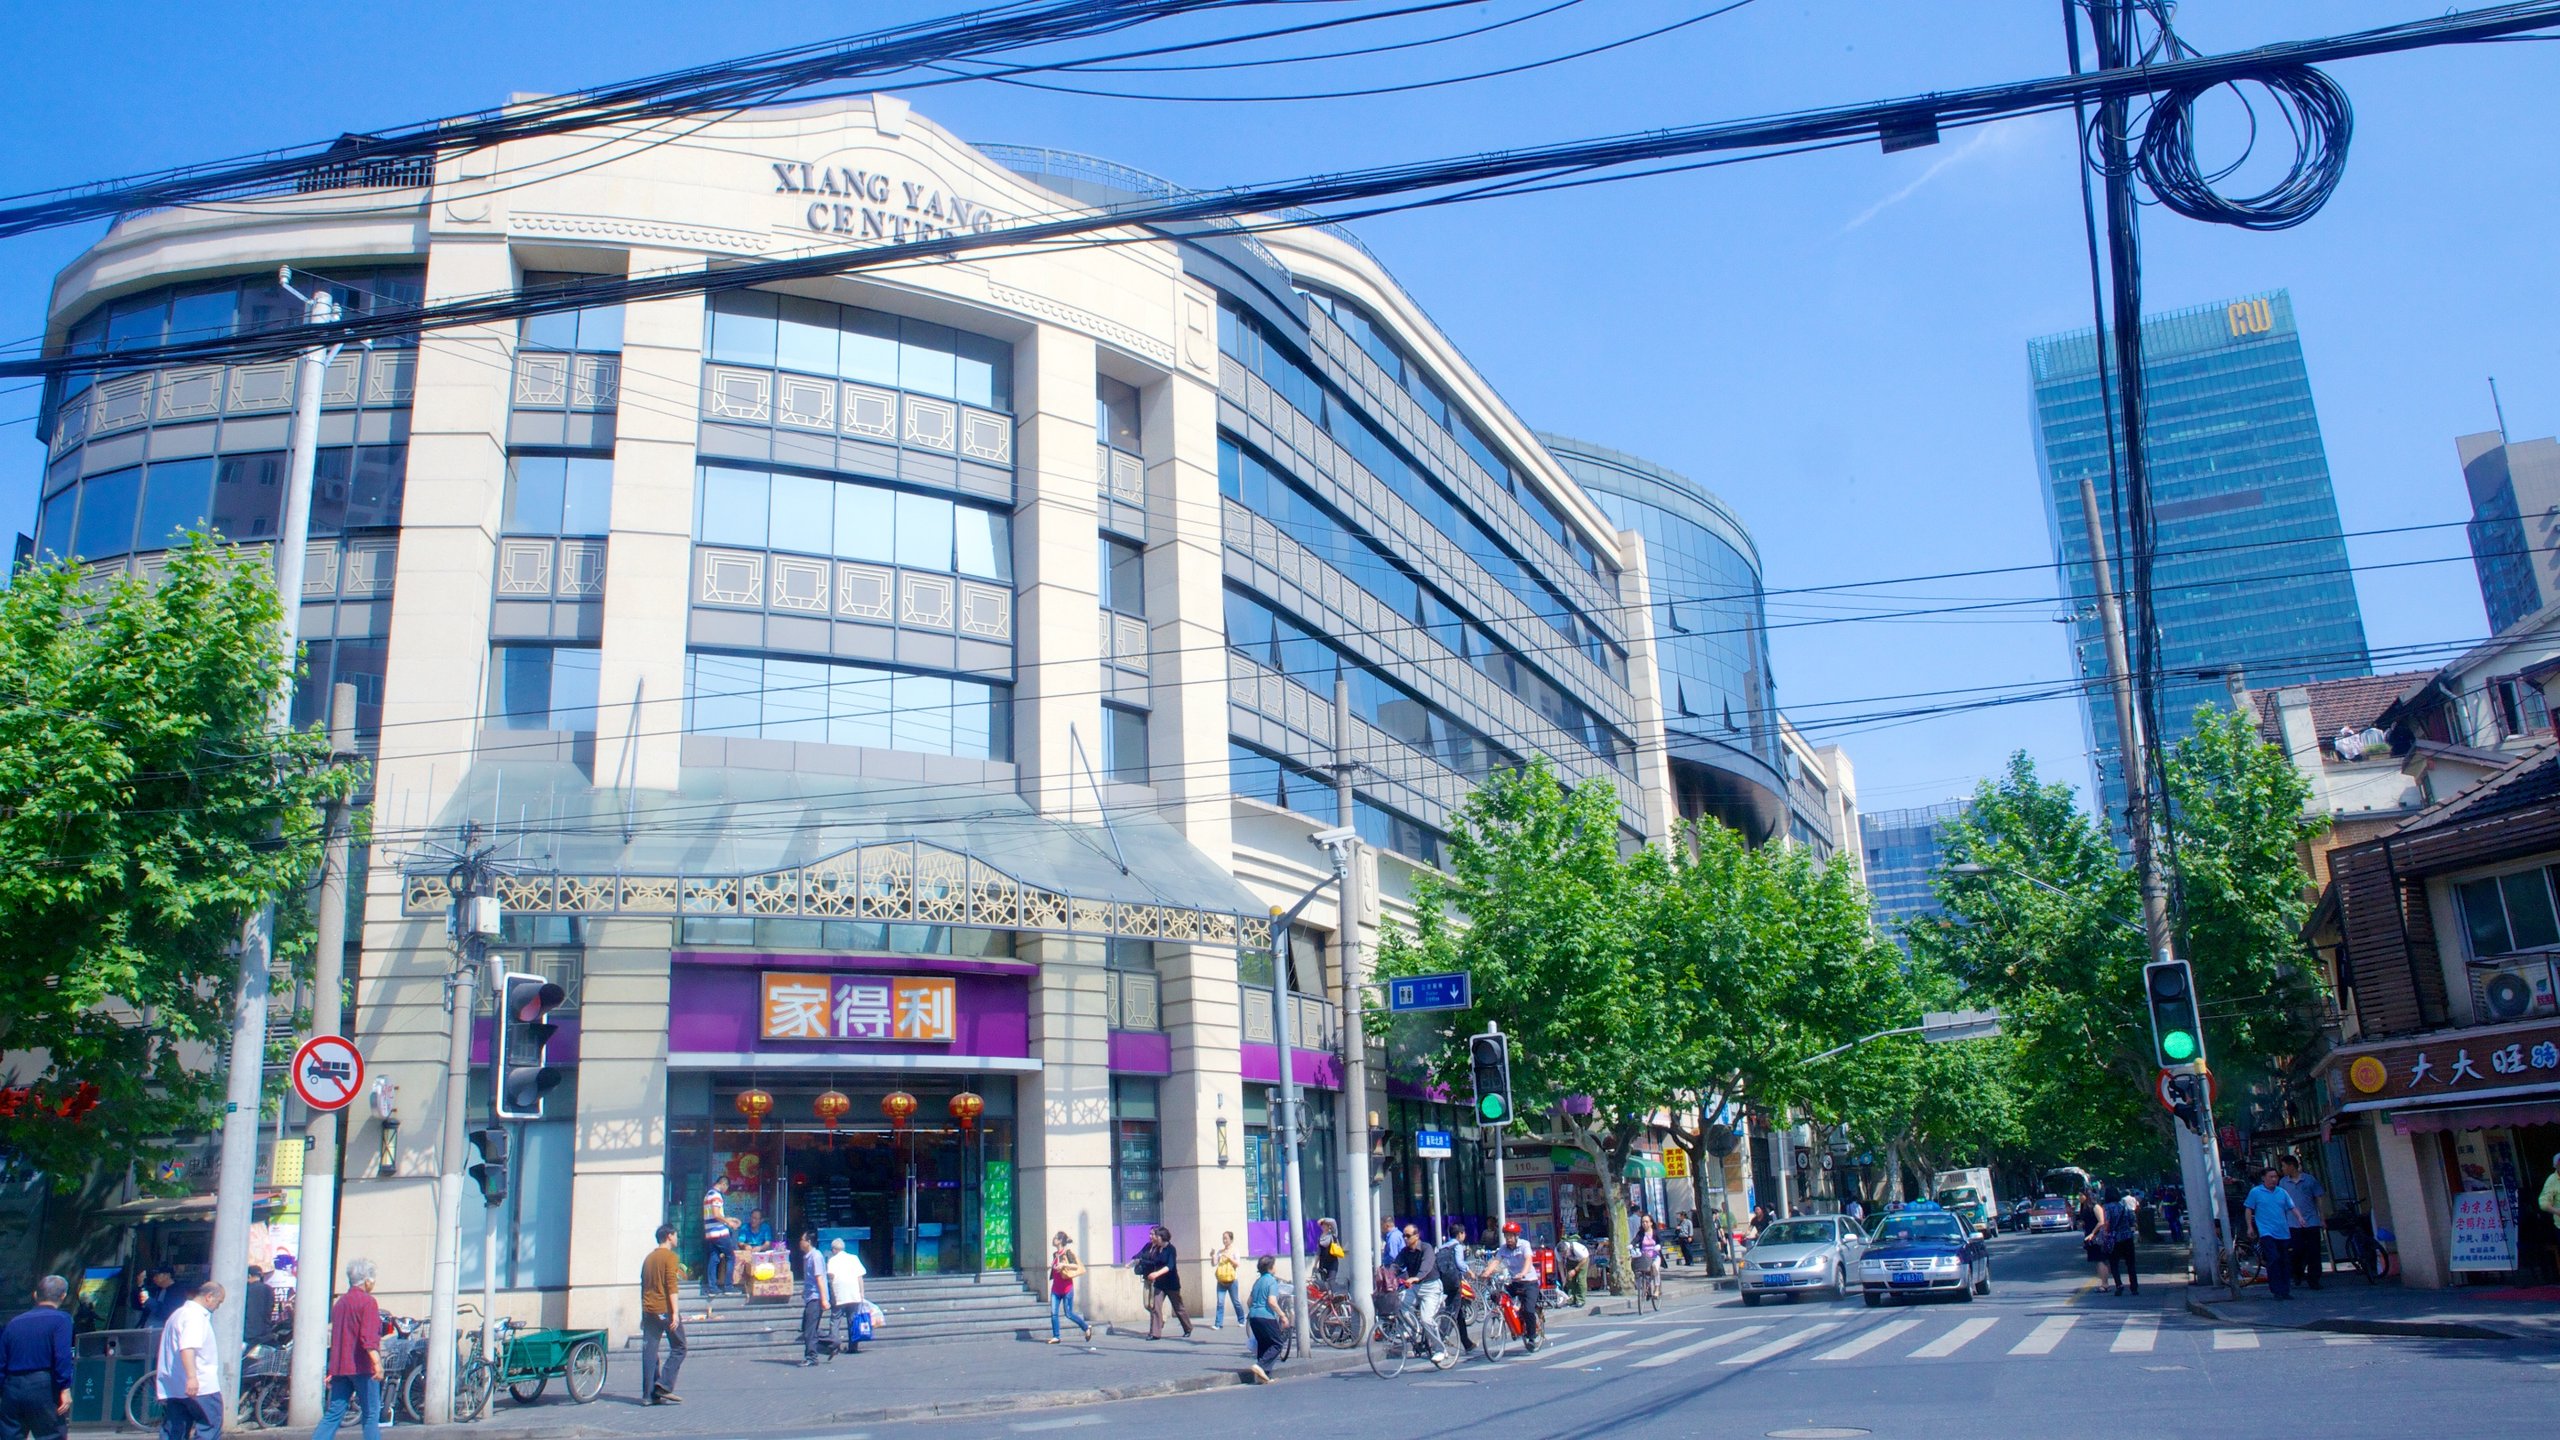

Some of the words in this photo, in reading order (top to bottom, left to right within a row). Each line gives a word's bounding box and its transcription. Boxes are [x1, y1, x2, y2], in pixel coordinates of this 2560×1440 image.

[772, 162, 890, 204] XIANG
[901, 180, 994, 235] YANG
[768, 982, 952, 1039] 家得利
